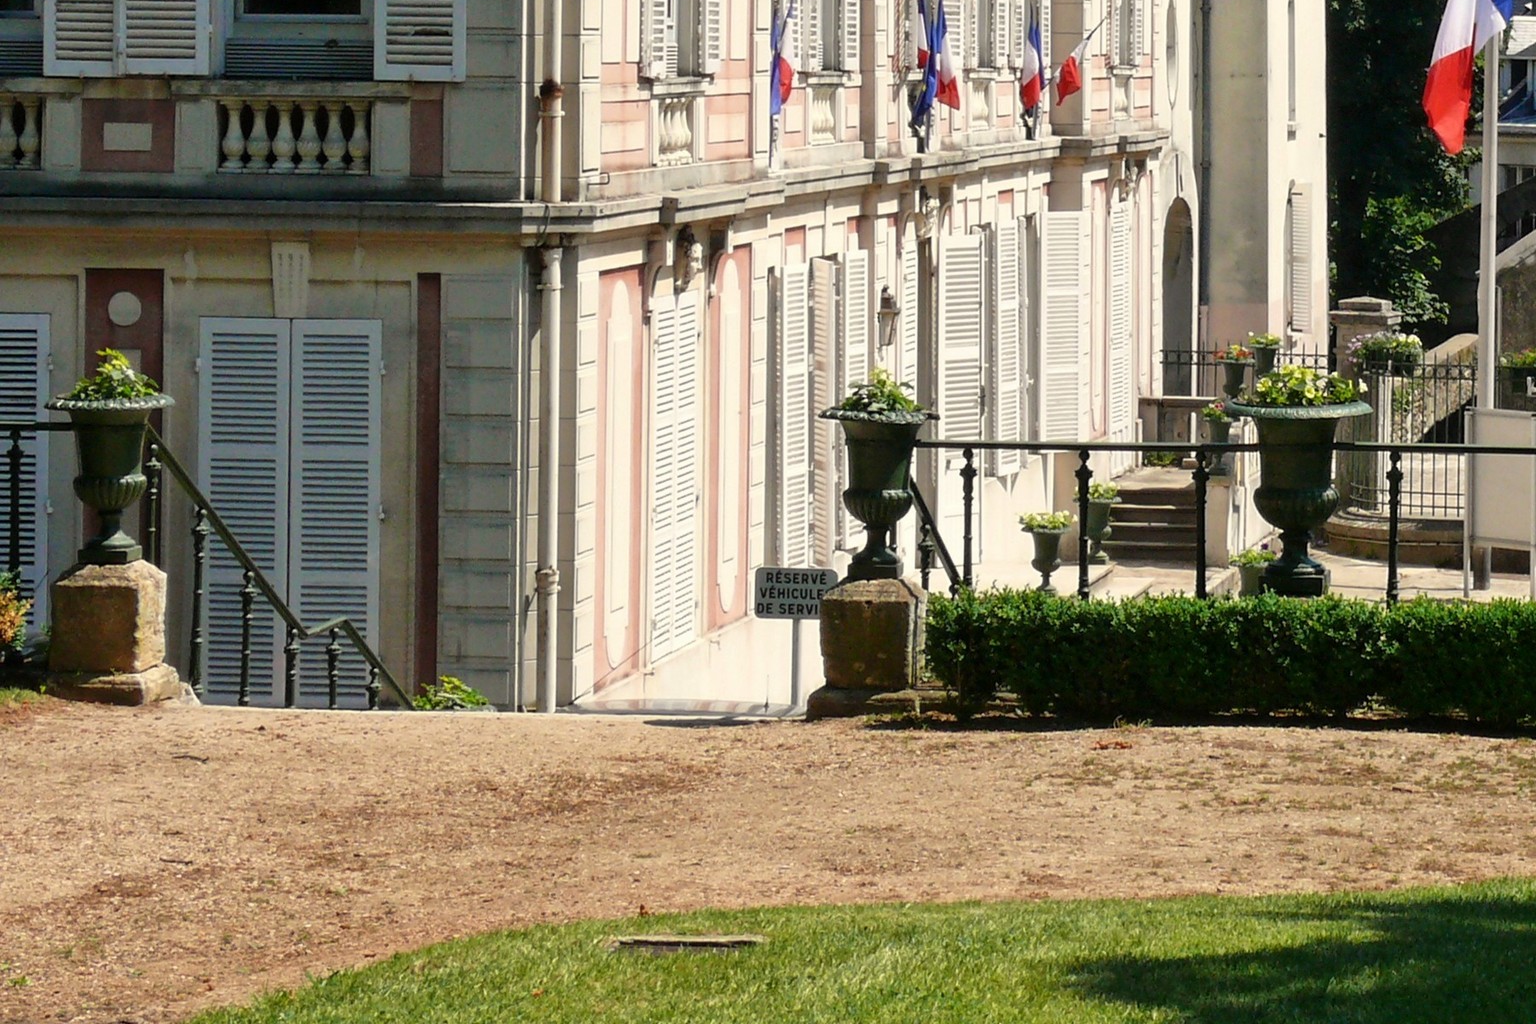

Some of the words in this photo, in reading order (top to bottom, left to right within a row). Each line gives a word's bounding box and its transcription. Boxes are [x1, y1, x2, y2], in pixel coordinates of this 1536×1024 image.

[766, 570, 827, 585] RÉSERVÉ
[760, 585, 826, 600] VÉHICULE
[757, 603, 773, 614] DE
[779, 603, 818, 615] SERVI
